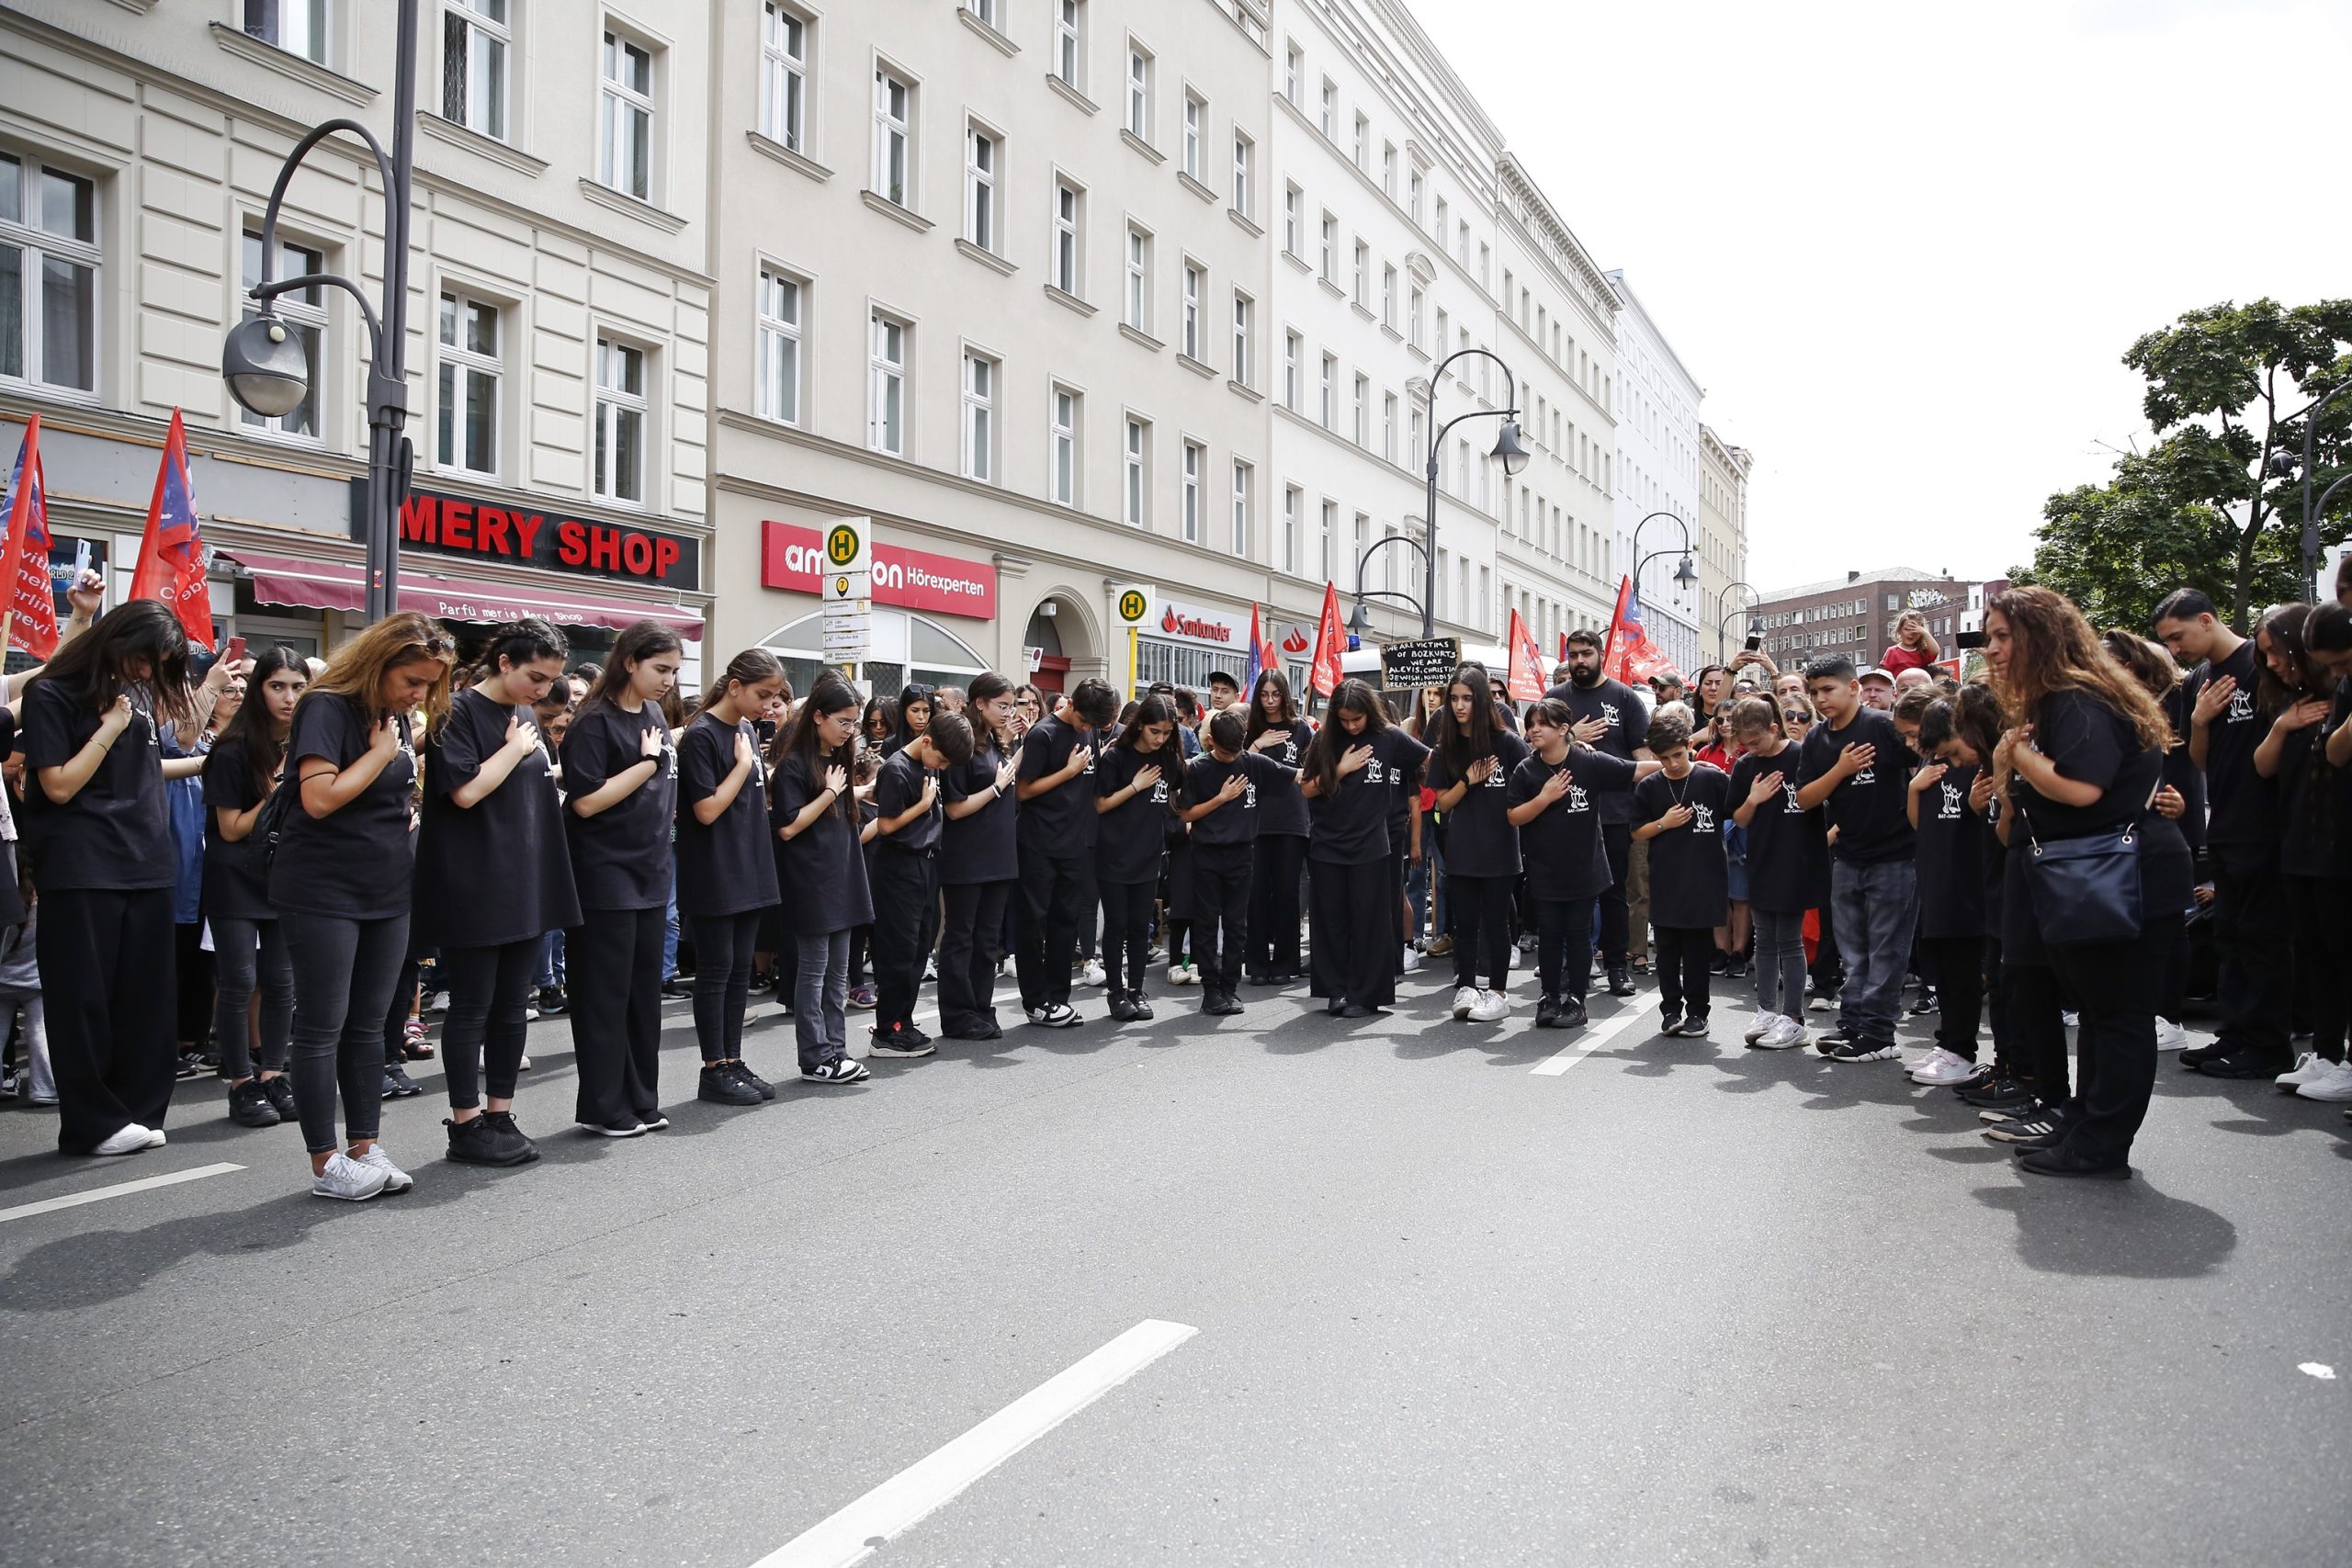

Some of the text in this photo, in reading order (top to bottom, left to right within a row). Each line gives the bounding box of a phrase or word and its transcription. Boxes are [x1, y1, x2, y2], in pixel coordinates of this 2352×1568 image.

[400, 493, 680, 579] MERY SHOP
[834, 534, 850, 558] H
[907, 566, 984, 597] Hörexperten
[14, 587, 52, 616] erlin
[439, 602, 583, 623] Parfü merie Mery Shop
[1125, 597, 1138, 615] H
[11, 607, 51, 636] mevi
[1177, 613, 1232, 642] Santander
[1411, 650, 1456, 659] BOZKURTS
